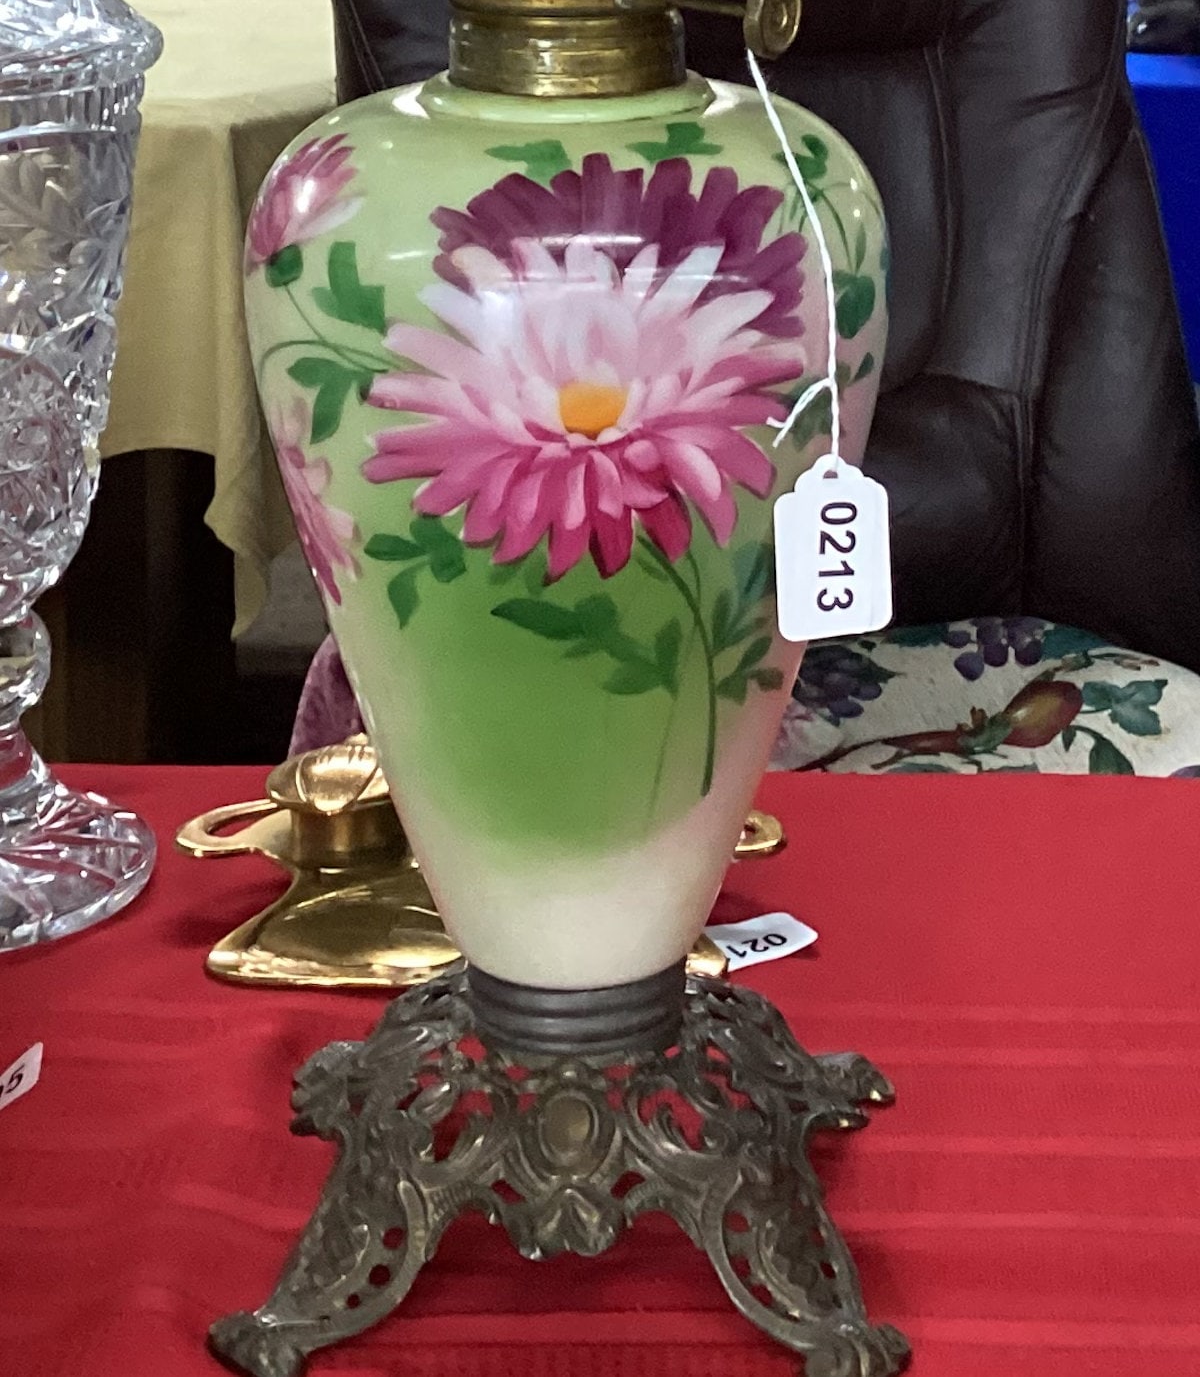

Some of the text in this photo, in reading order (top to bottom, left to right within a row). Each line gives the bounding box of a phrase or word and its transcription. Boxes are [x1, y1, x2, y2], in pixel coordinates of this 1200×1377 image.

[817, 502, 858, 612] 0213
[725, 933, 788, 960] 021
[0, 1064, 24, 1098] 5
